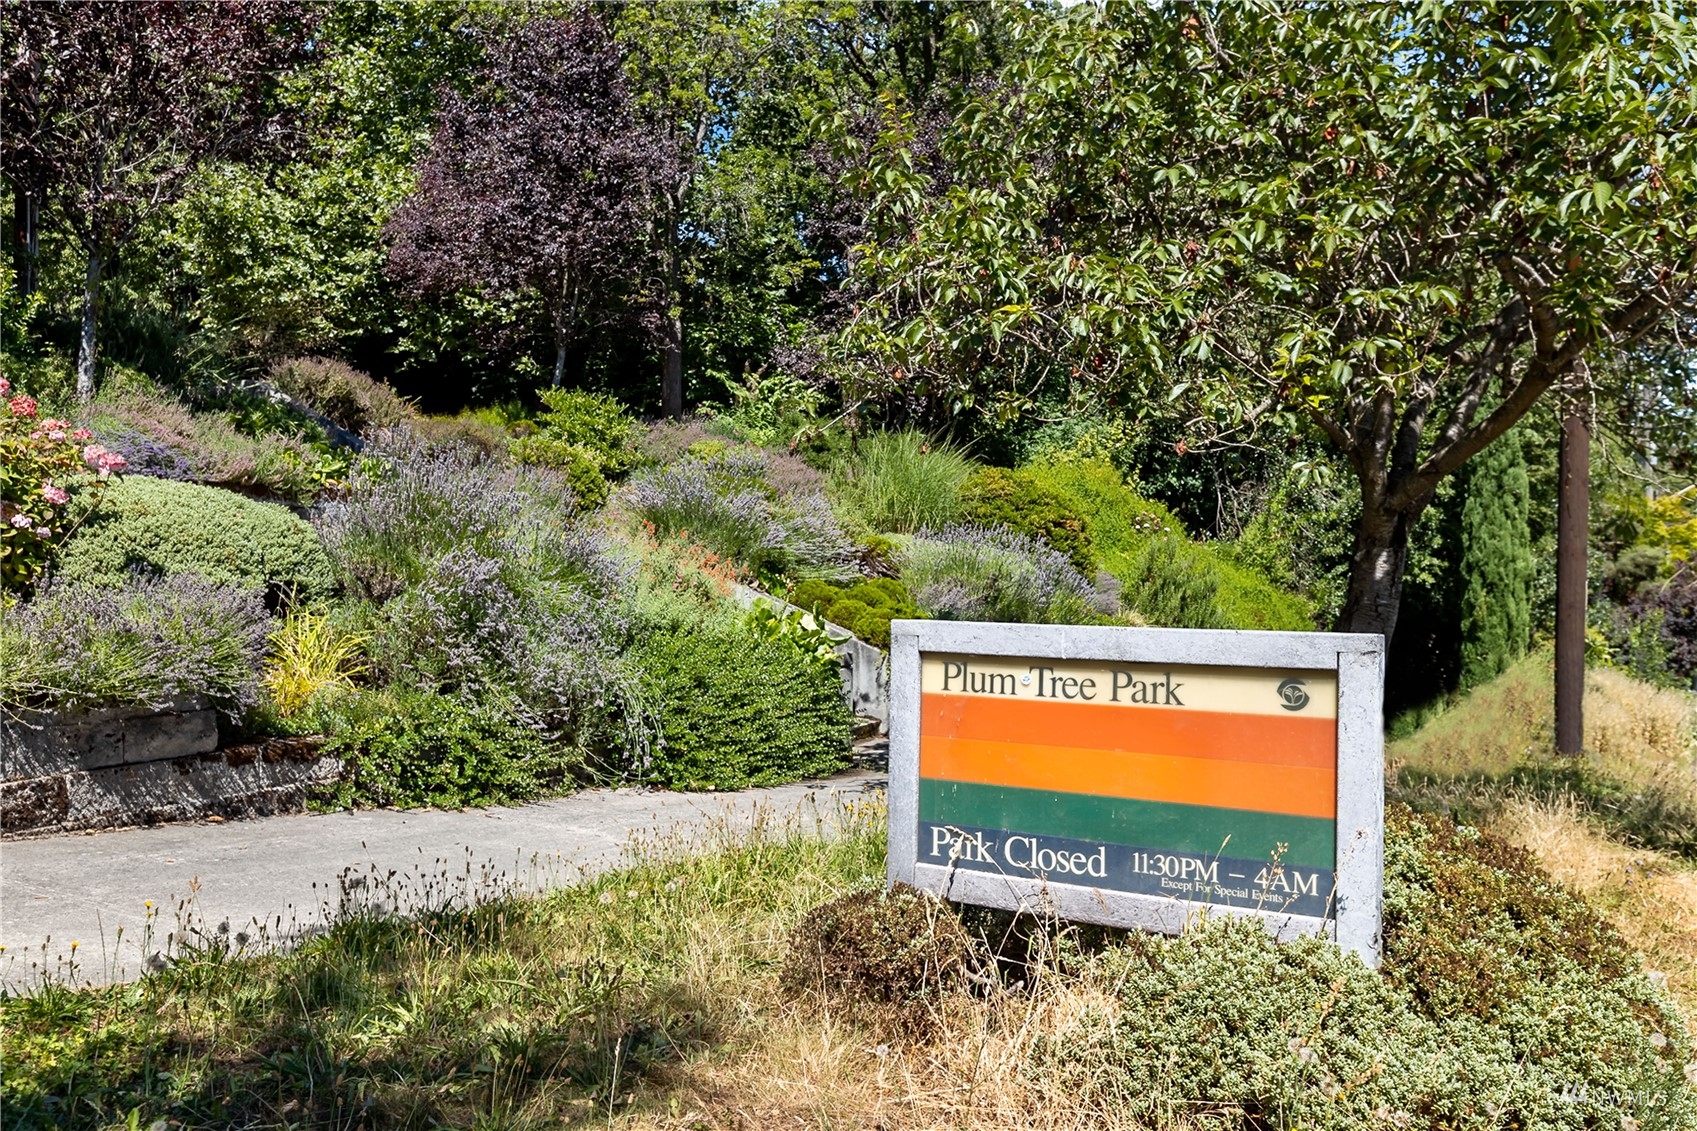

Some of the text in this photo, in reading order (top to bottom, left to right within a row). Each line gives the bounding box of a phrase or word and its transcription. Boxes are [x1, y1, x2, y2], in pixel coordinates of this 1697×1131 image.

[941, 661, 1185, 706] Plum Tree Park
[929, 826, 995, 863] Park
[1004, 835, 1108, 878] Closed
[1132, 852, 1220, 883] 11:30PM
[1254, 867, 1320, 896] 4AM
[1161, 878, 1284, 903] Except For Special Events
